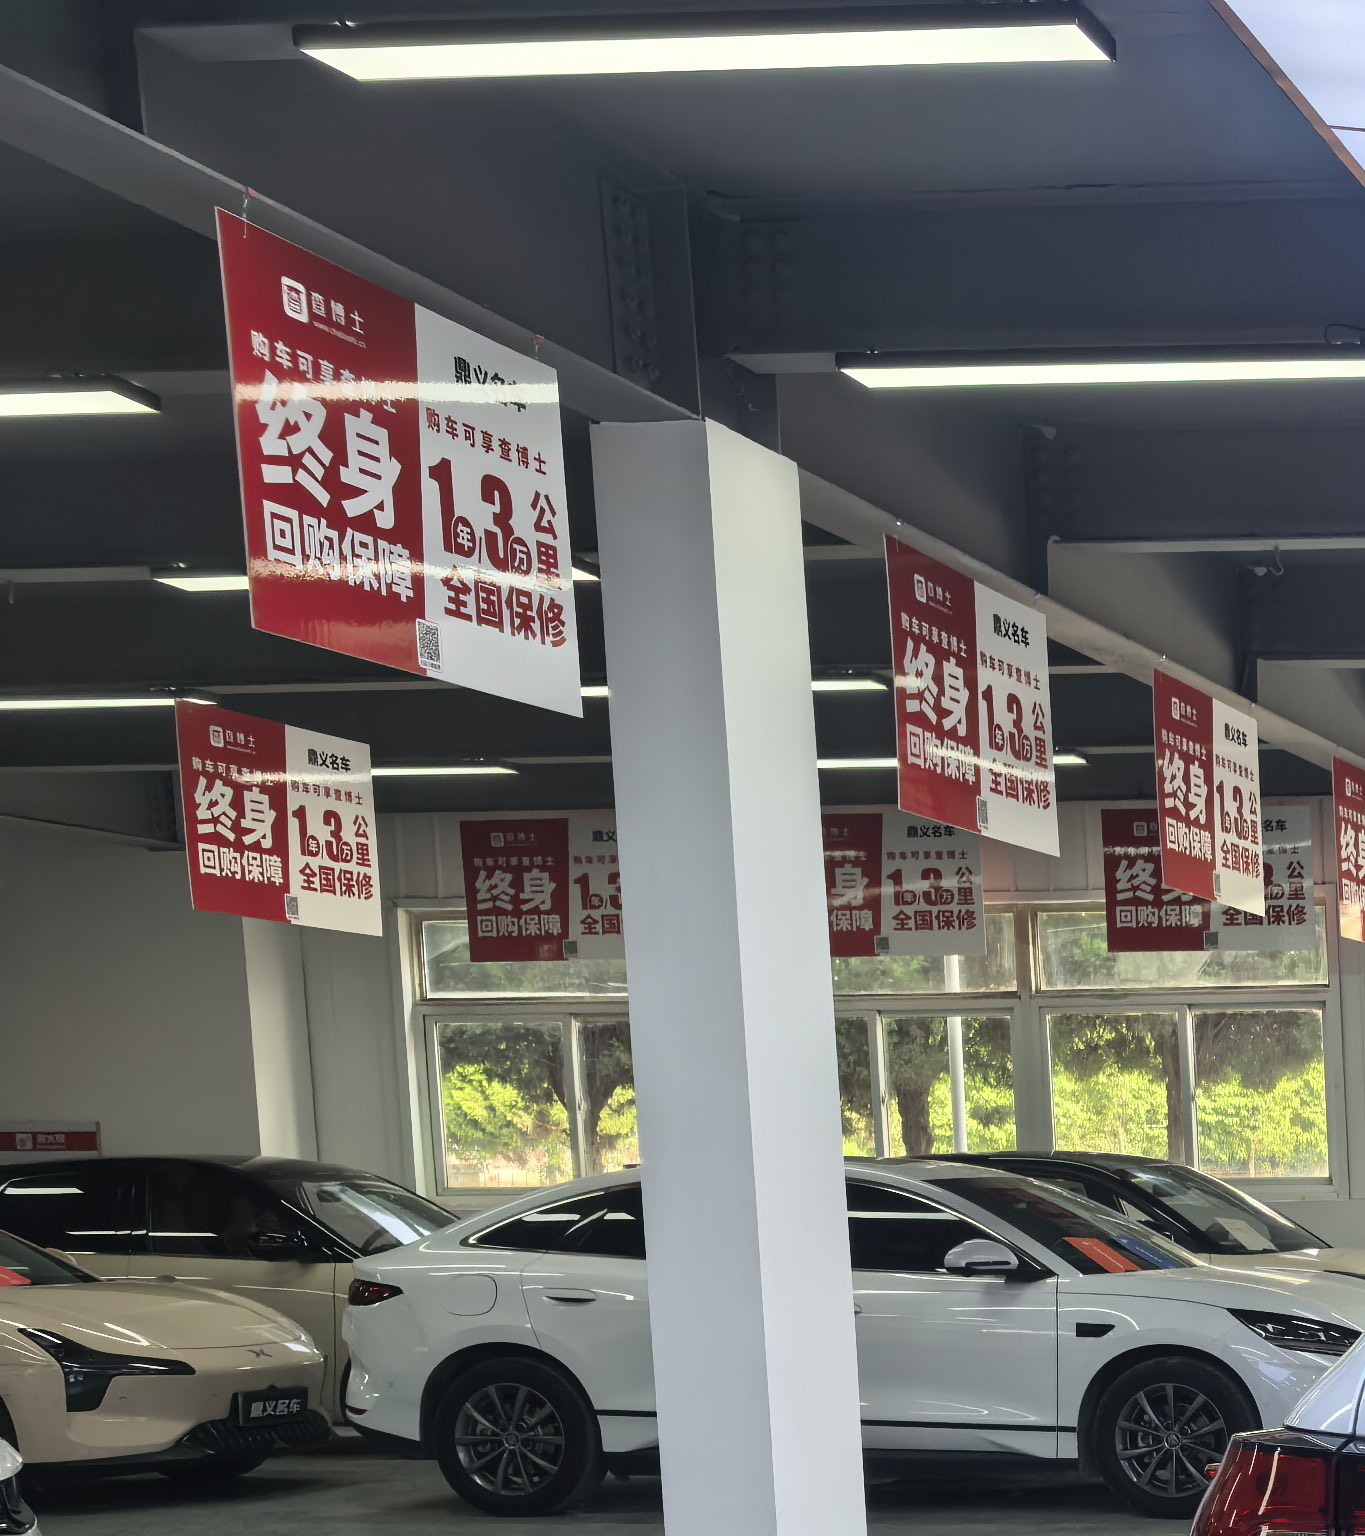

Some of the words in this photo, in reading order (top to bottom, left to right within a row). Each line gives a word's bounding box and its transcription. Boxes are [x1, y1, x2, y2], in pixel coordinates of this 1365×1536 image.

[254, 368, 402, 530] 终身
[426, 406, 547, 475] 购车可享查博士
[263, 498, 414, 603] 回购保障
[443, 563, 568, 648] 全国保修
[993, 613, 1029, 648] 鼎义名车
[902, 636, 969, 738] 终身
[307, 748, 351, 773] 鼎义名车
[907, 722, 976, 786] 回购保障
[988, 752, 1051, 811] 全国保修
[1163, 748, 1208, 825] 终身
[194, 775, 276, 848] 终身
[1165, 817, 1213, 863] 回购保障
[1221, 838, 1260, 879] 全国保修
[198, 843, 284, 886] 回购保障
[299, 862, 373, 901] 全国保修
[831, 863, 869, 906] 身
[475, 868, 556, 911] 终身
[477, 915, 562, 938] 回购保障
[830, 910, 873, 931] 保障
[892, 909, 976, 931] 全国保修
[1116, 905, 1203, 929] 回购保障
